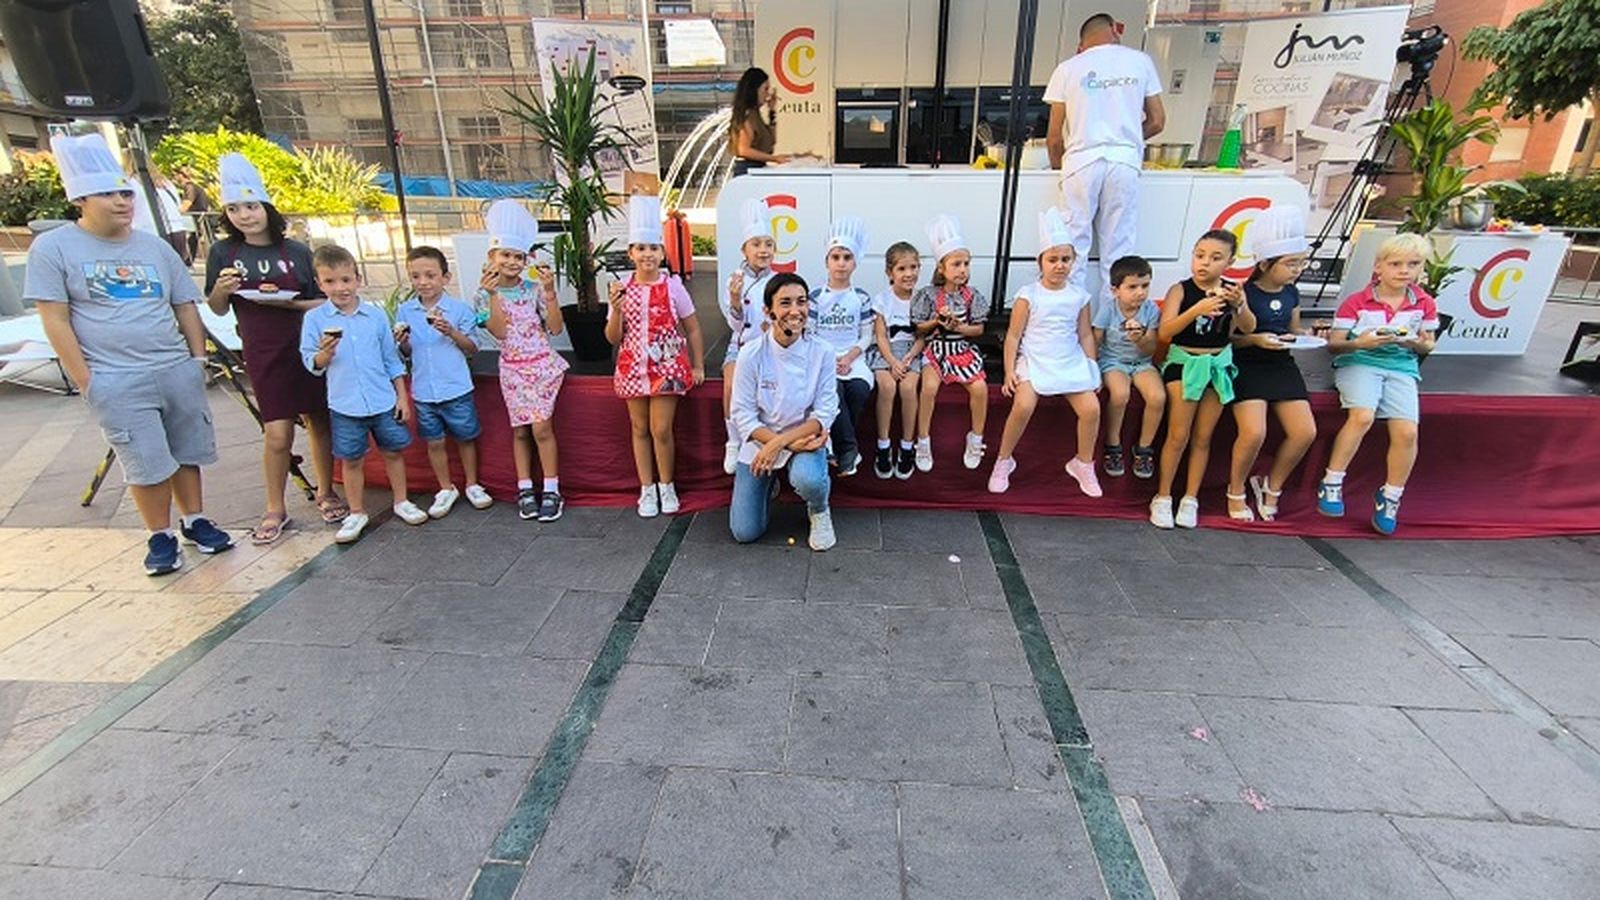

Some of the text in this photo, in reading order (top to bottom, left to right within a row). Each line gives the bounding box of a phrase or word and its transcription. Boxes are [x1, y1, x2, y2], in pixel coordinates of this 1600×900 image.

[1253, 82, 1309, 95] COCINAS
[779, 101, 821, 113] euta
[1447, 320, 1509, 339] Ceuta
